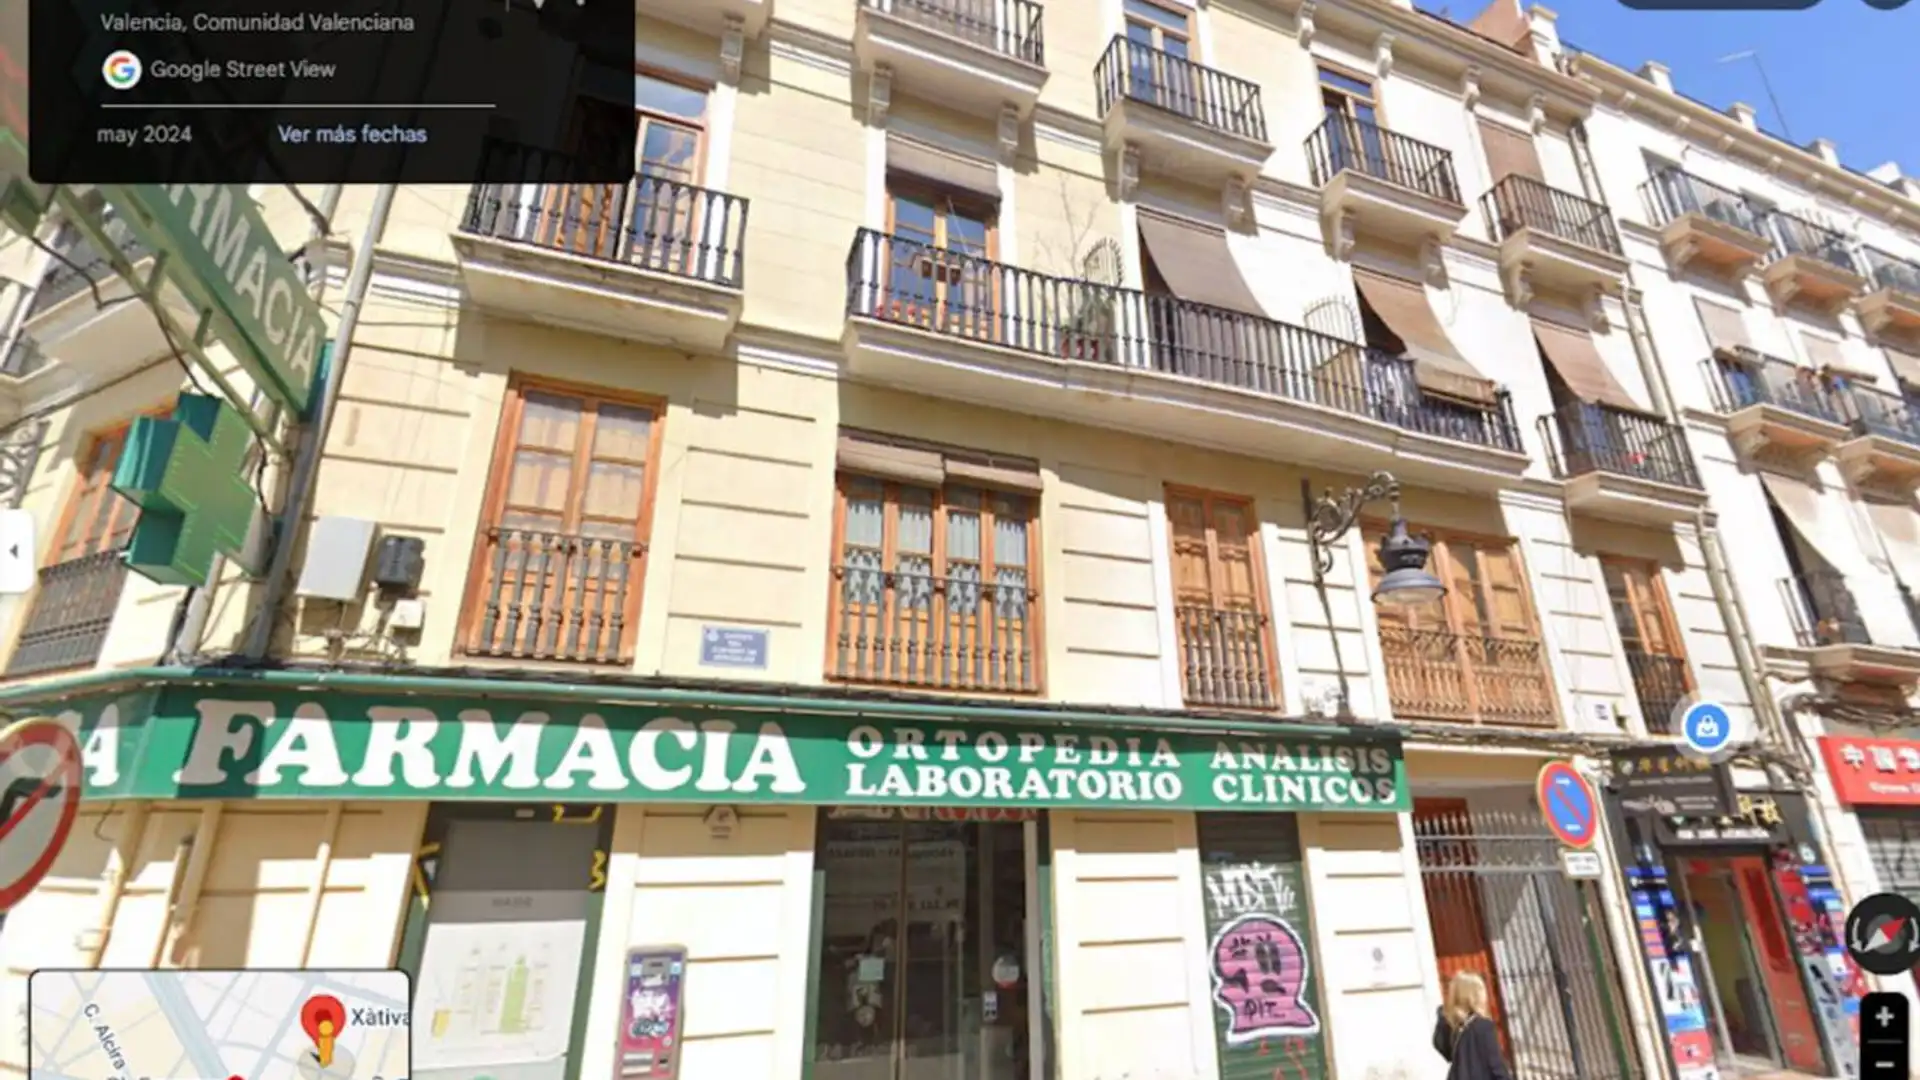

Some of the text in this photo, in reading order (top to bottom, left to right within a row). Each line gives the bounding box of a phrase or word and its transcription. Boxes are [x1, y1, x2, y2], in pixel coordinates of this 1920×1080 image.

[172, 699, 807, 793] FARMACIA
[847, 726, 1181, 768] ORTOPEDIA
[1209, 741, 1392, 775] ANALISIS
[845, 763, 1183, 801] LABORATORIO
[1212, 774, 1397, 805] CLINICOS
